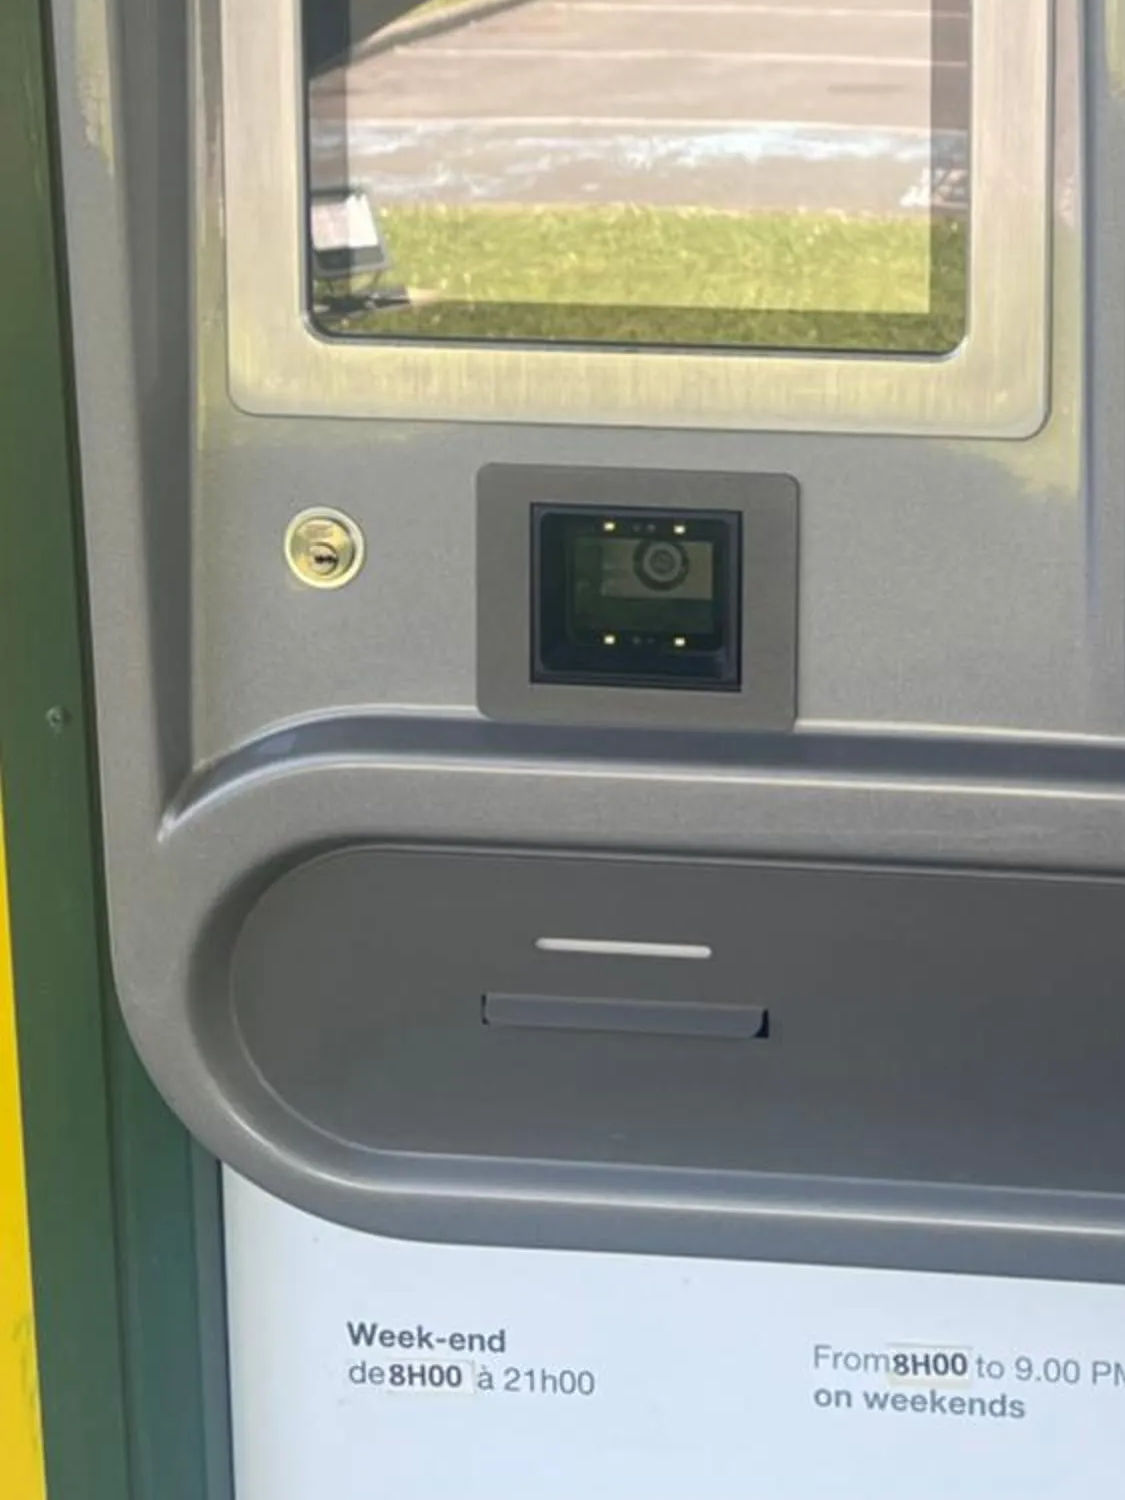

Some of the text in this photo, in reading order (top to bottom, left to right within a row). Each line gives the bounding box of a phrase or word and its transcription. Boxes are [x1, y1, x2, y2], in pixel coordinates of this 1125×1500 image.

[346, 1321, 507, 1353] Week-end
[348, 1361, 596, 1396] de 8H00 à 21h00
[813, 1345, 890, 1373] From
[892, 1352, 969, 1377] 8H00
[976, 1356, 1006, 1379] to
[1014, 1356, 1081, 1384] 9.00
[813, 1387, 1026, 1419] on weekends
